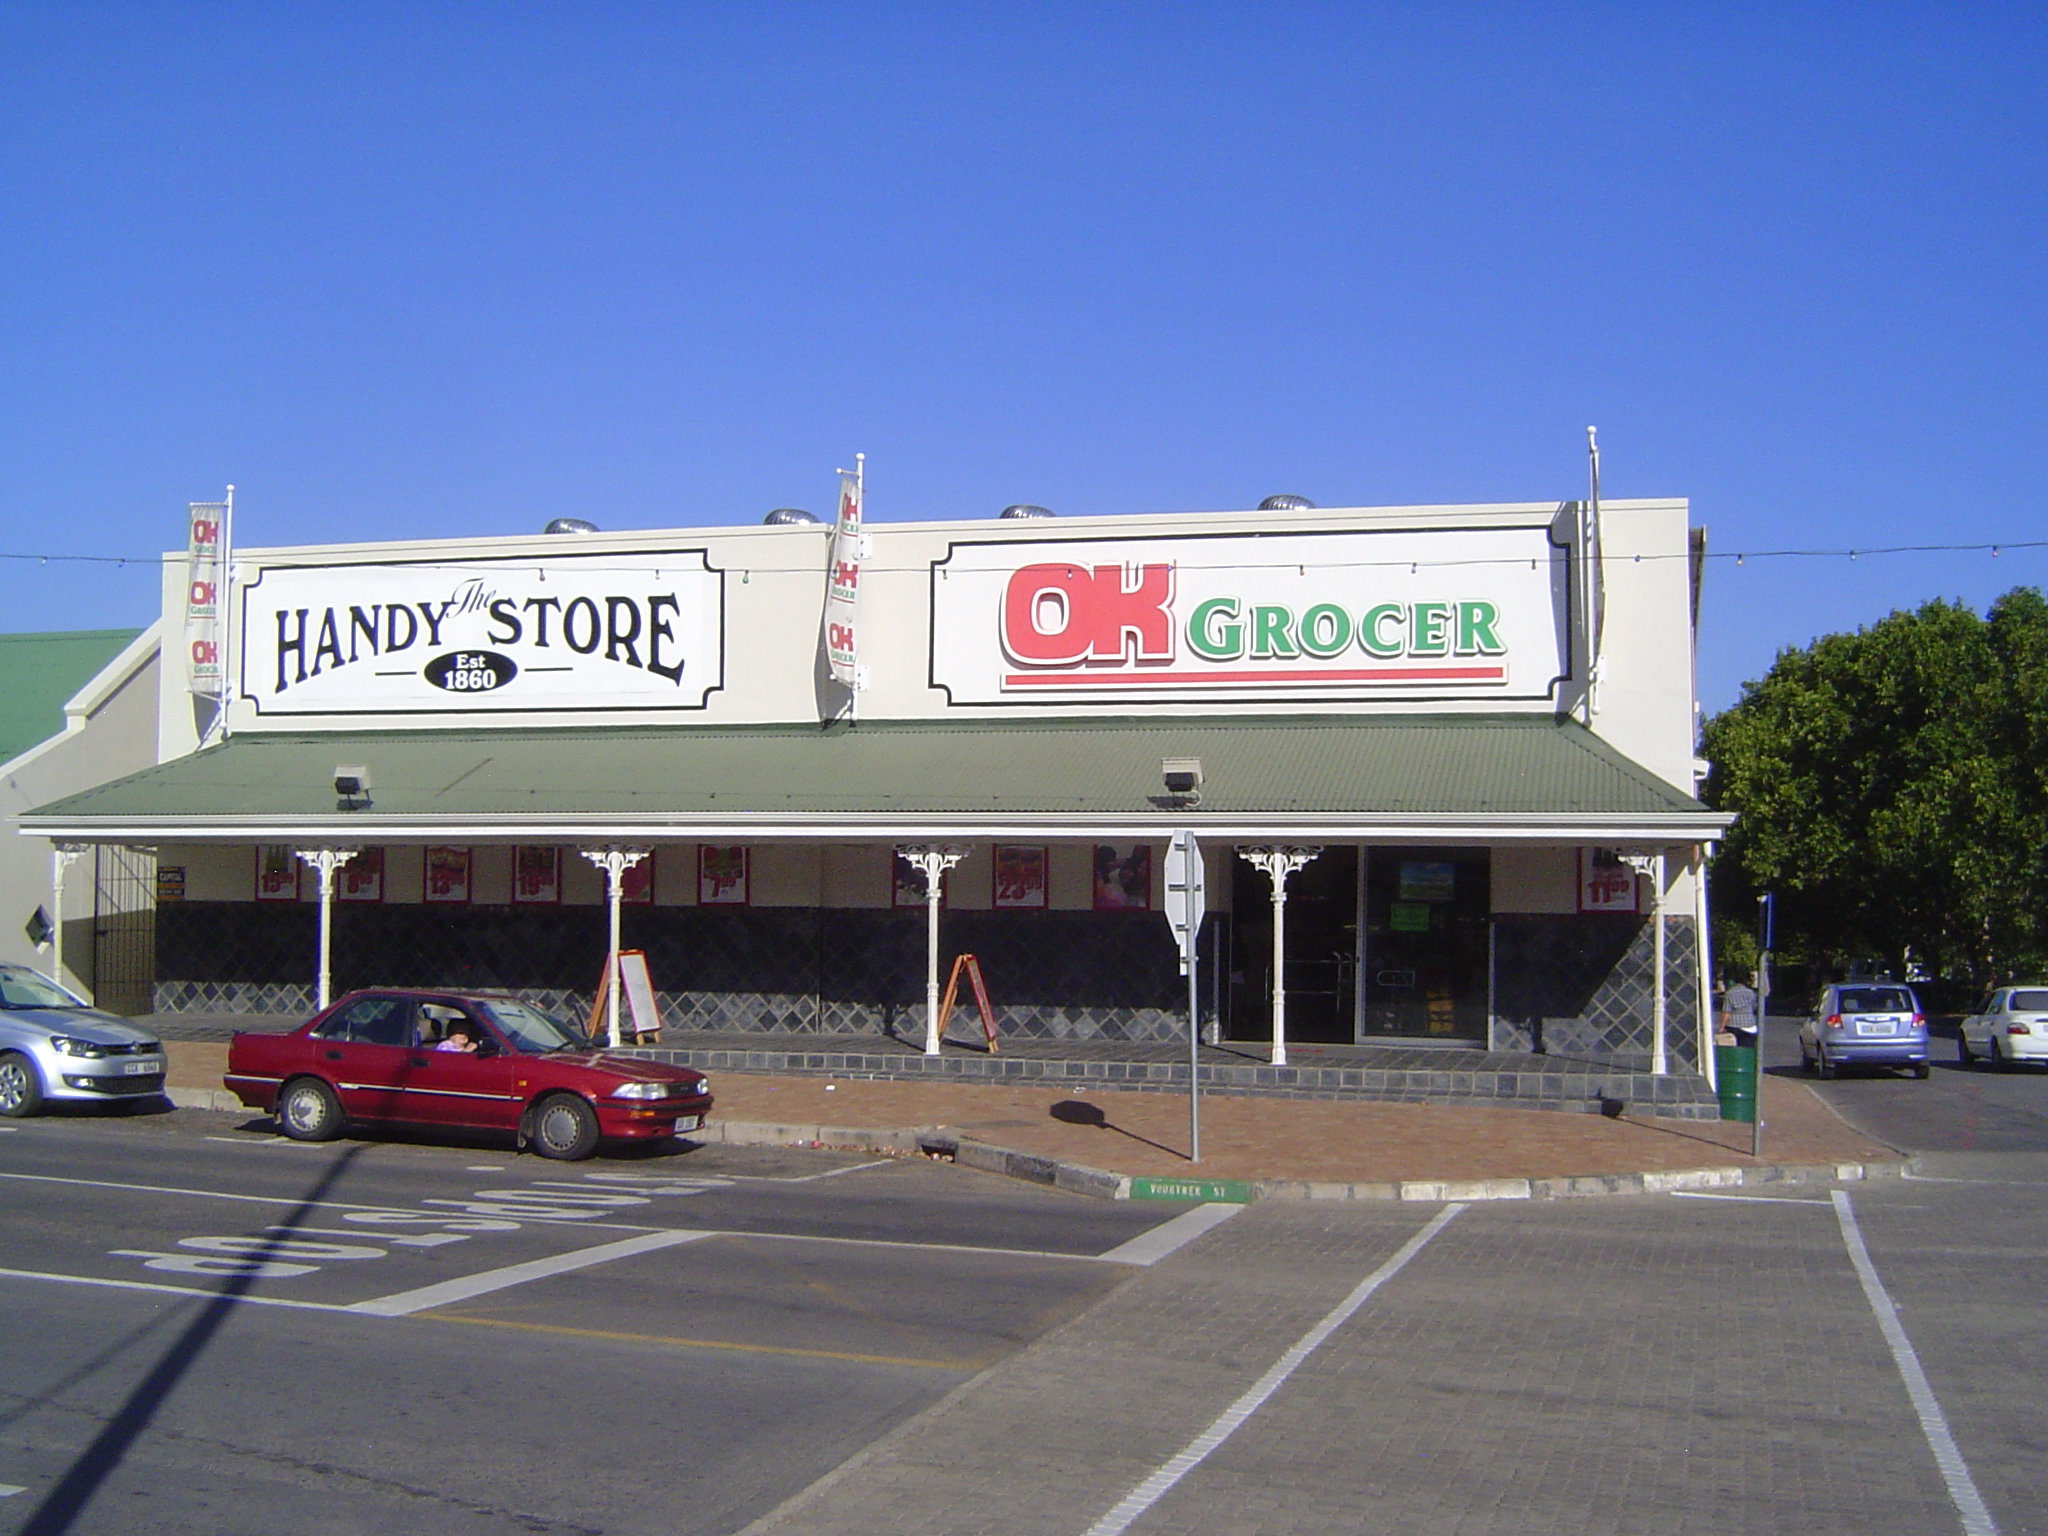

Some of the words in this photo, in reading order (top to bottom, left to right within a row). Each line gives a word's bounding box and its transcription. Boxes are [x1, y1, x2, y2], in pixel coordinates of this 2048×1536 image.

[834, 560, 858, 588] OK
[446, 577, 496, 618] The
[1003, 561, 1175, 664] OK
[1189, 598, 1504, 658] GROCER
[275, 601, 459, 694] HANDY
[487, 592, 685, 691] STORE
[829, 622, 854, 652] OK
[454, 653, 486, 669] Est
[444, 669, 497, 690] 1860
[1212, 1186, 1225, 1198] ST
[107, 1212, 522, 1278] STOP
